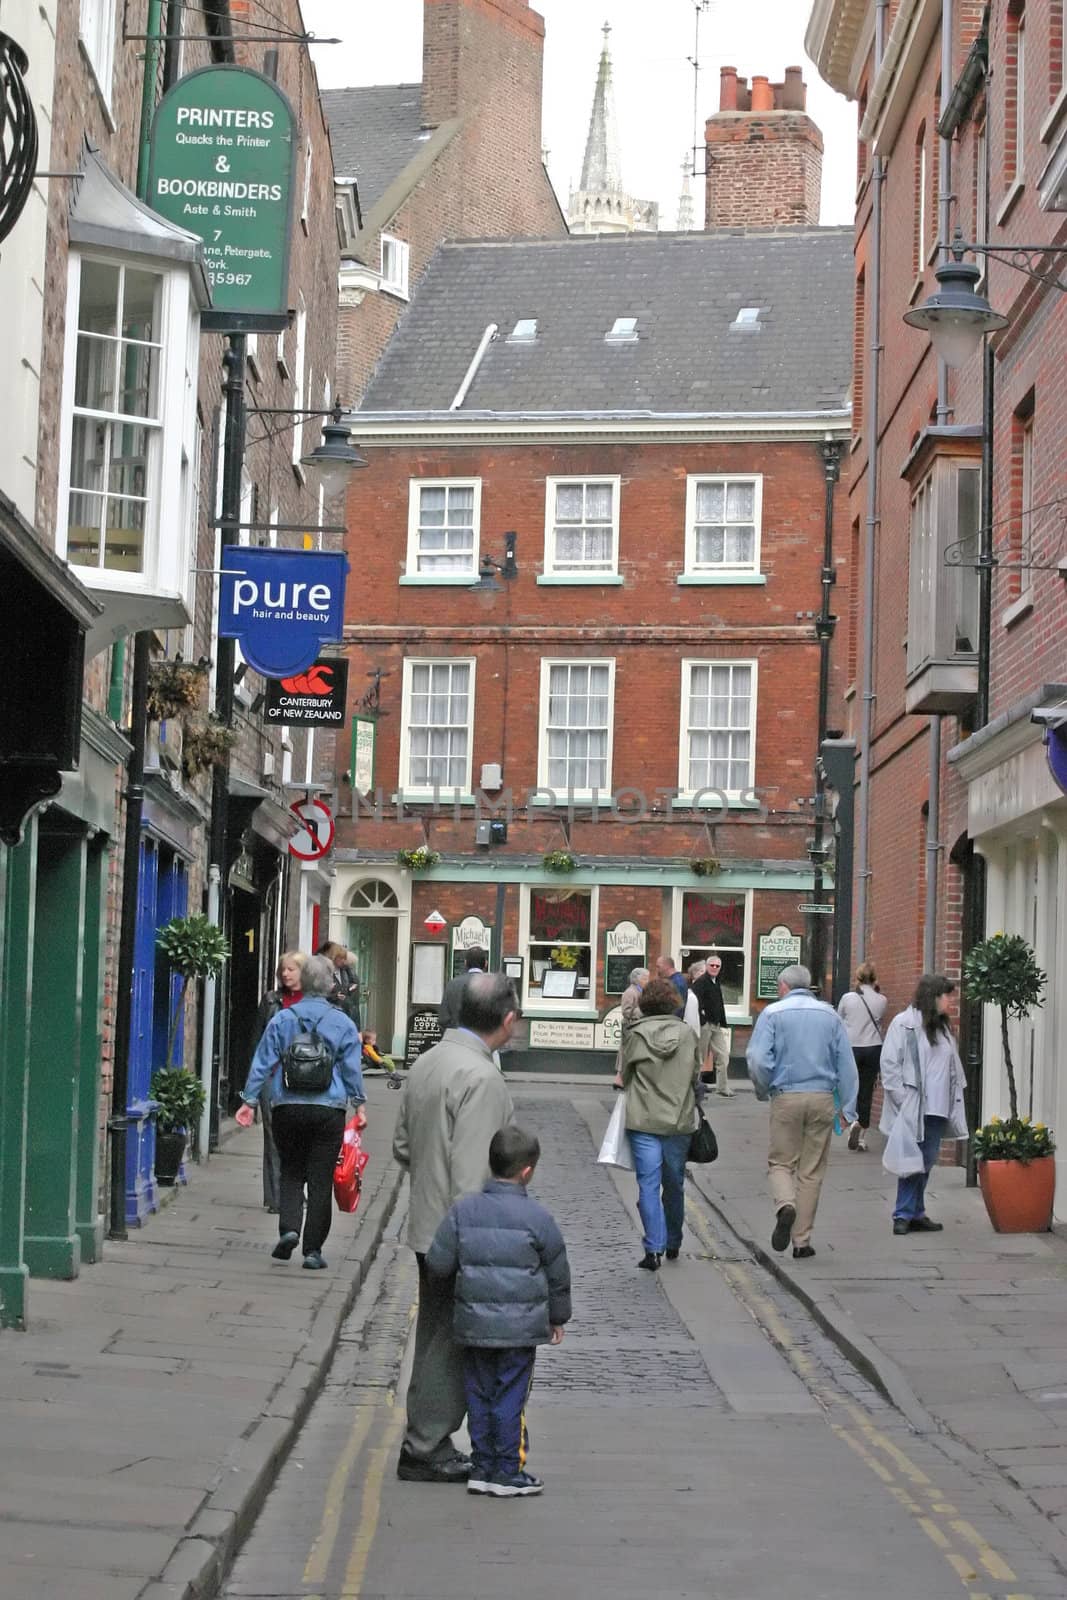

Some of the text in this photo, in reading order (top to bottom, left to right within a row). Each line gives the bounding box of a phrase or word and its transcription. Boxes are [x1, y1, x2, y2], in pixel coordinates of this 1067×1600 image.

[176, 107, 274, 129] PRINTERS
[175, 132, 271, 148] Quacks the Printer
[215, 155, 231, 173] &
[157, 178, 282, 201] BOOKBINDERS
[183, 203, 257, 217] Aste & Smith
[213, 229, 223, 241] 7
[233, 579, 331, 615] pure
[252, 607, 330, 624] hair and beauty
[279, 697, 333, 708] CANTERBURY
[268, 708, 342, 720] OF NEW ZEALAND
[244, 929, 255, 953] 1
[454, 927, 489, 946] Michael's
[609, 932, 644, 951] Michael's
